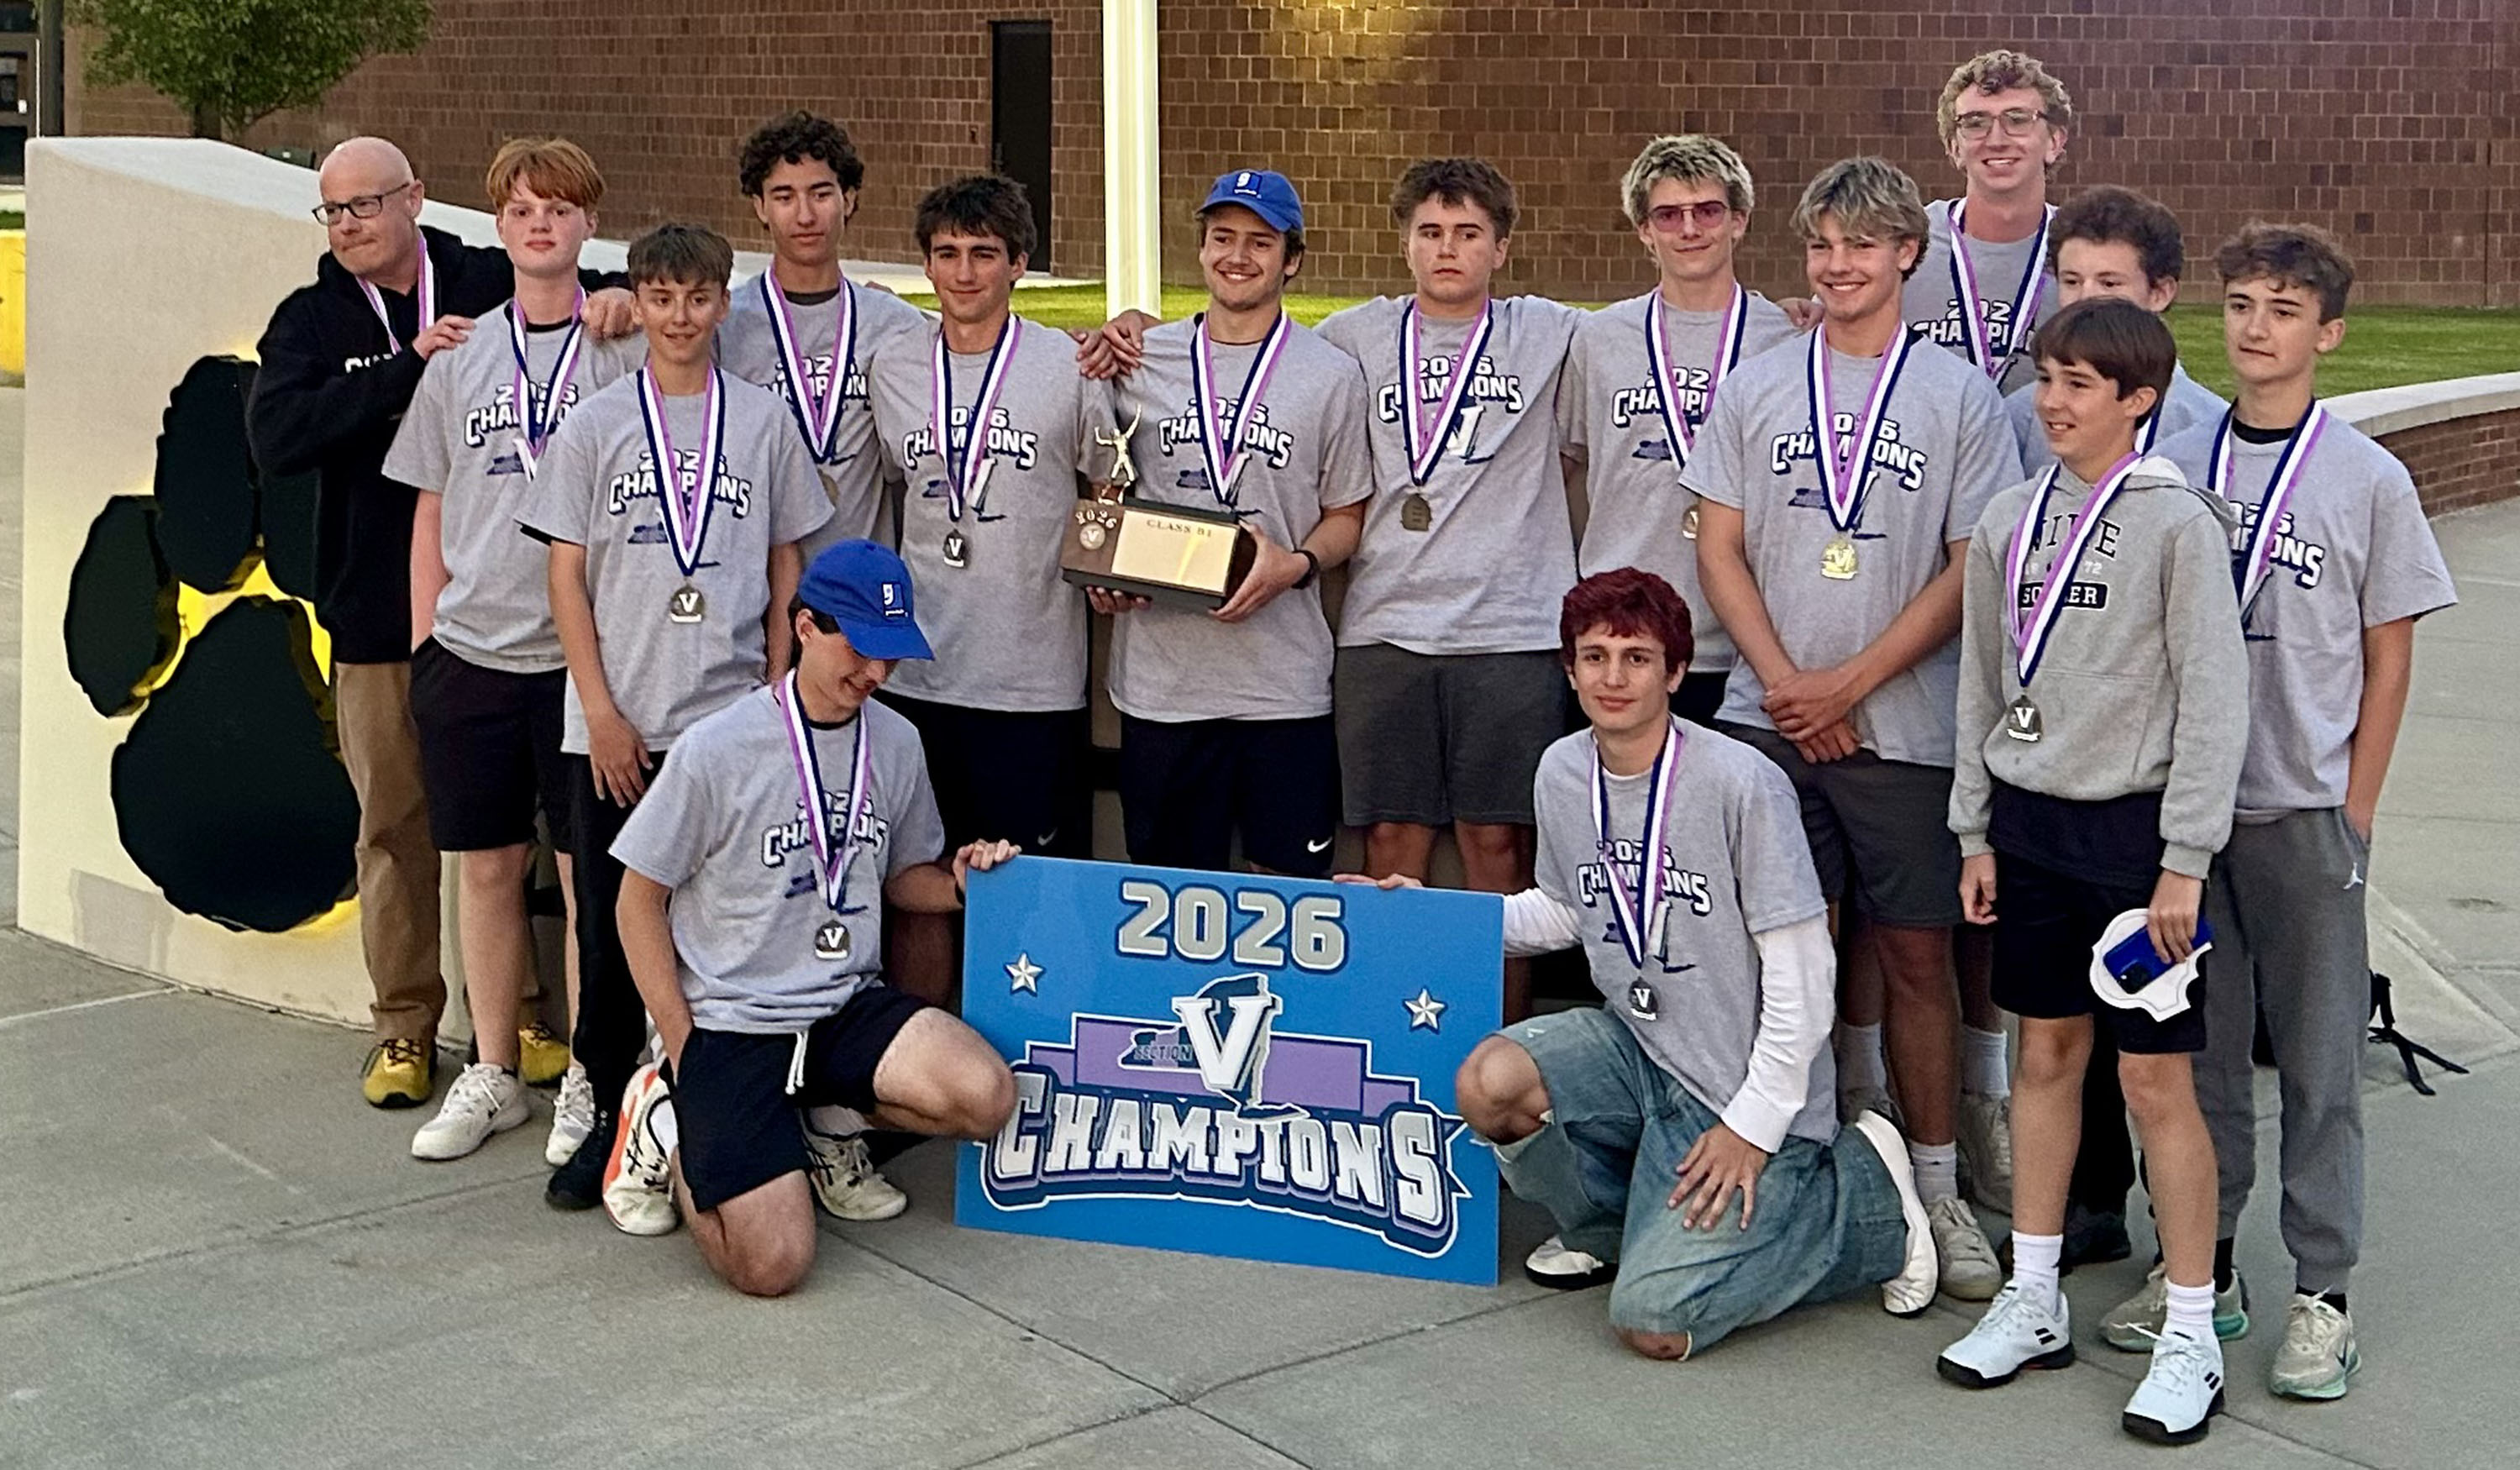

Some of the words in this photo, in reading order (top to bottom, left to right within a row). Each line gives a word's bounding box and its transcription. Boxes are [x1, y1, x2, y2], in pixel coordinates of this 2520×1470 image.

[1075, 509, 1117, 529] 2026
[1147, 519, 1191, 534] CLASS
[679, 592, 699, 612] V
[2014, 706, 2034, 728] V
[1118, 879, 1347, 972] 2026
[824, 927, 845, 948] V
[1633, 987, 1651, 1008] V
[1134, 1043, 1193, 1063] SECTION
[1173, 994, 1280, 1092] V
[994, 1070, 1446, 1230] CHAMPIONS
